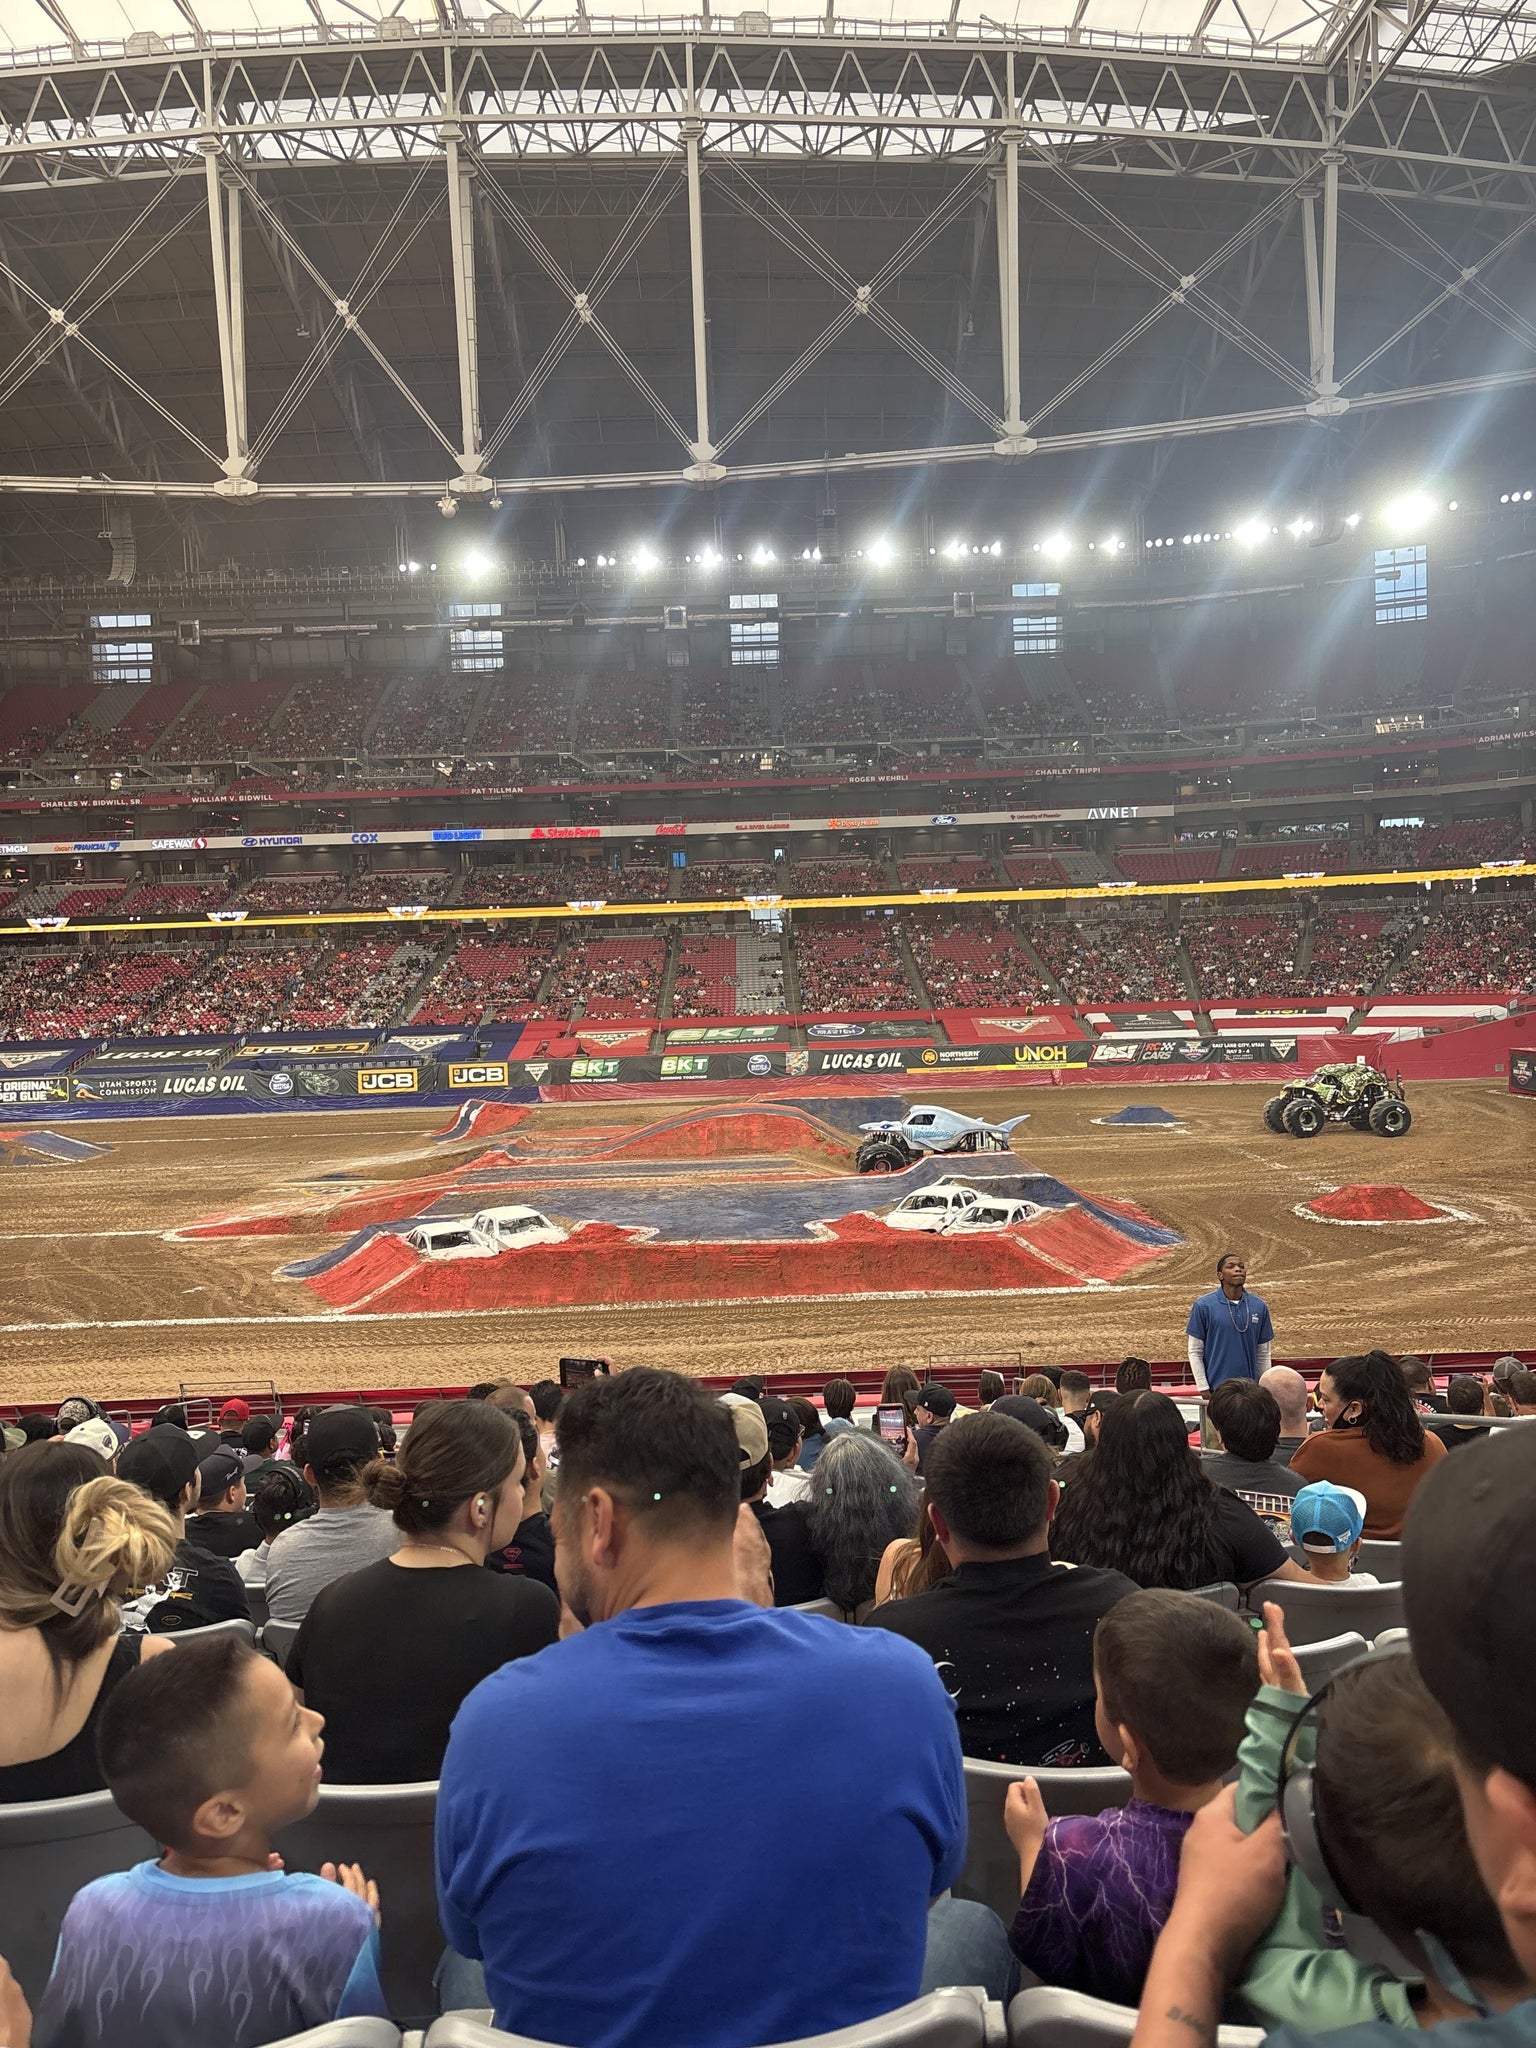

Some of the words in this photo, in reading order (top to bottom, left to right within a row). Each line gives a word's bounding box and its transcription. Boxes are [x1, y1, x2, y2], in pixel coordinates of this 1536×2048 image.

[1478, 733, 1511, 744] ADRIAN
[1035, 768, 1072, 776] CHARLEY
[1074, 767, 1101, 775] TRIPPI
[40, 800, 78, 808] CHARLES
[191, 796, 228, 804] WILLIAM
[238, 794, 273, 802] BIDWILL
[1087, 806, 1139, 819] AVNET
[546, 828, 573, 839] State
[574, 826, 600, 838] Farm
[151, 838, 194, 849] SAFEWAY
[259, 836, 302, 845] HYUNDAI
[351, 833, 378, 844] COX
[1145, 1042, 1161, 1051] RC
[939, 1050, 980, 1058] NORTHERN
[1014, 1045, 1067, 1061] UNOH
[1142, 1051, 1173, 1060] CARS
[661, 1058, 708, 1073] BKT
[821, 1053, 875, 1069] LUCAS
[362, 1073, 413, 1088] JCB
[453, 1067, 504, 1083] JCB
[3, 1081, 52, 1092] ORIGINAL
[125, 1079, 157, 1087] SPORTS
[163, 1077, 217, 1094] LUCAS
[20, 1091, 48, 1101] GLUE
[99, 1088, 157, 1096] COMMISSION
